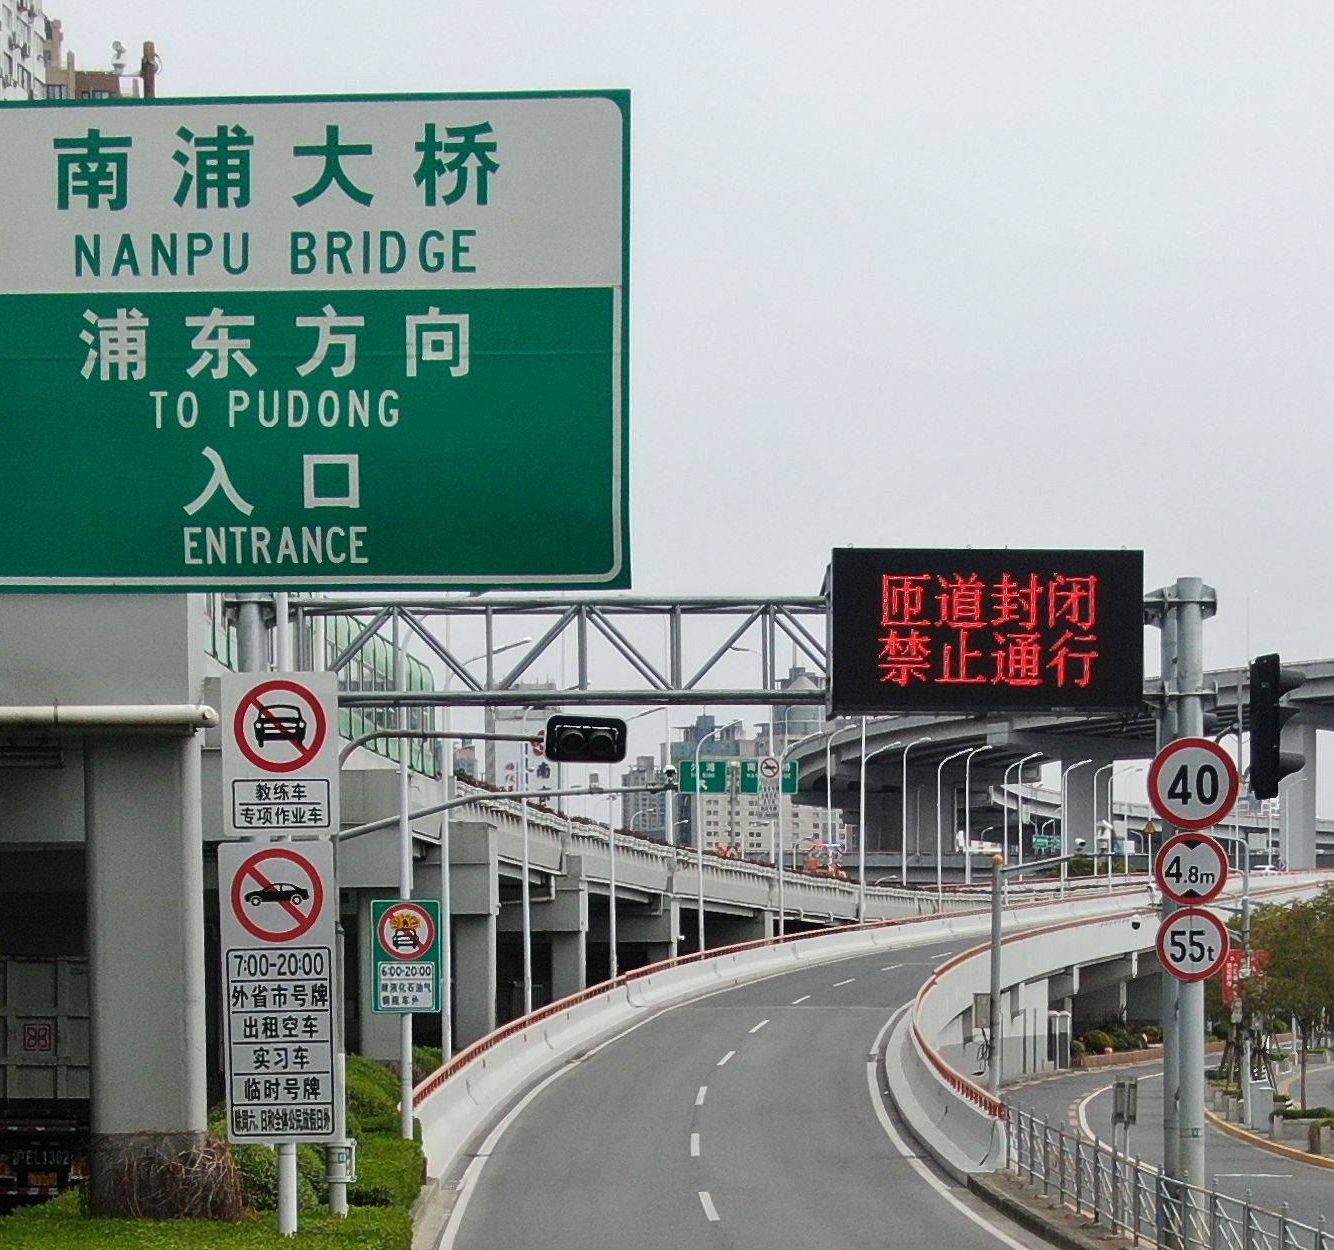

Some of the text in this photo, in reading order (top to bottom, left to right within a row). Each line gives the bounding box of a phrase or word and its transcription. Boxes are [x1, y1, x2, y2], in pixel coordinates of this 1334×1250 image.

[53, 121, 500, 211] 南浦大桥
[74, 228, 478, 278] NANPU BRIDGE
[80, 305, 472, 382] 浦东方向
[150, 389, 401, 430] TO PUDONG
[183, 447, 361, 517] 入口
[183, 526, 369, 567] ENTRANCE
[881, 572, 1098, 629] 匝道封闭
[878, 628, 1099, 688] 禁止通行
[255, 783, 307, 801] 教练车
[1167, 764, 1219, 806] 40
[240, 807, 323, 825] 专项作业车
[1164, 855, 1215, 885] 4.8m
[1170, 930, 1215, 963] 55t
[233, 952, 324, 977] 7:00-20:00
[381, 966, 432, 977] 6:00-20:00
[231, 984, 329, 1009] 外省市号牌
[243, 1015, 319, 1039] 出租空车
[253, 1046, 310, 1070] 实习车
[244, 1077, 321, 1102] 临时号牌
